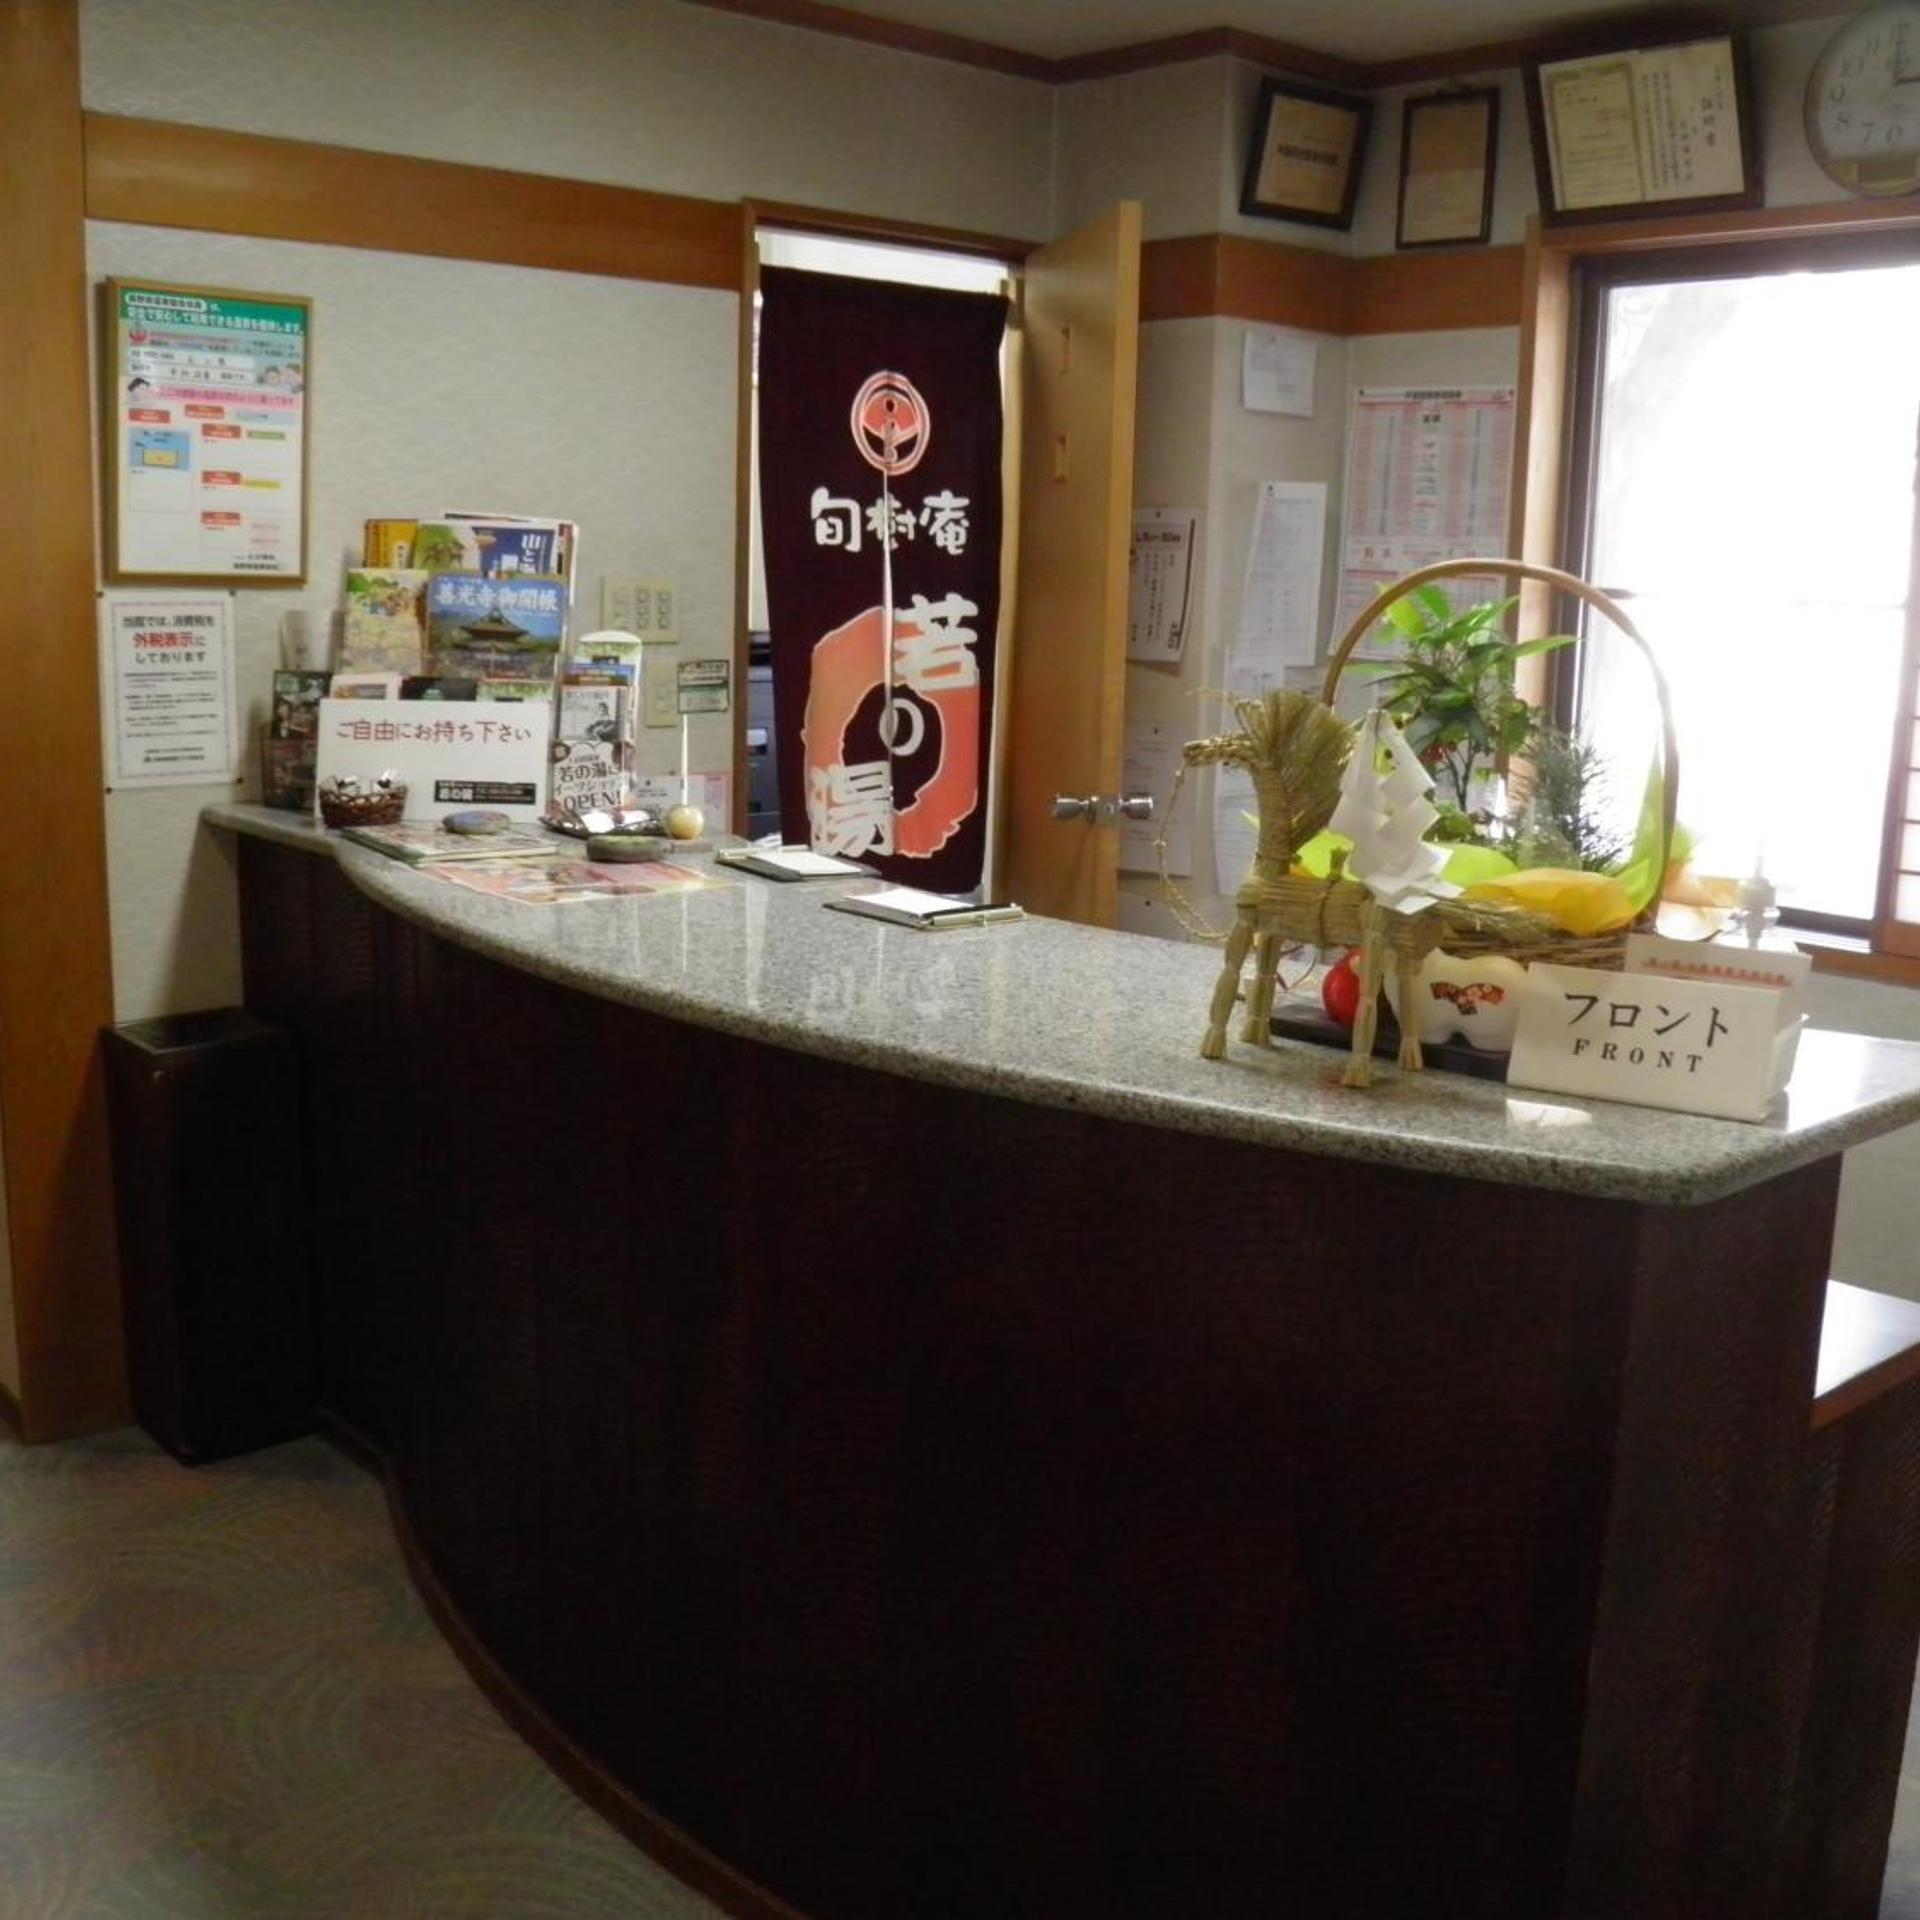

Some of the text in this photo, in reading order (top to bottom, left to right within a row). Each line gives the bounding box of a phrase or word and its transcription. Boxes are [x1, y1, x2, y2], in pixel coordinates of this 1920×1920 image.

[811, 486, 970, 555] 旬樹庵
[435, 581, 560, 613] 善光寺御開帳
[135, 651, 206, 665] しております
[336, 719, 532, 743] ご自由にお持ち下さい
[1564, 992, 1730, 1048] フロント
[1572, 1037, 1705, 1074] FRONT
